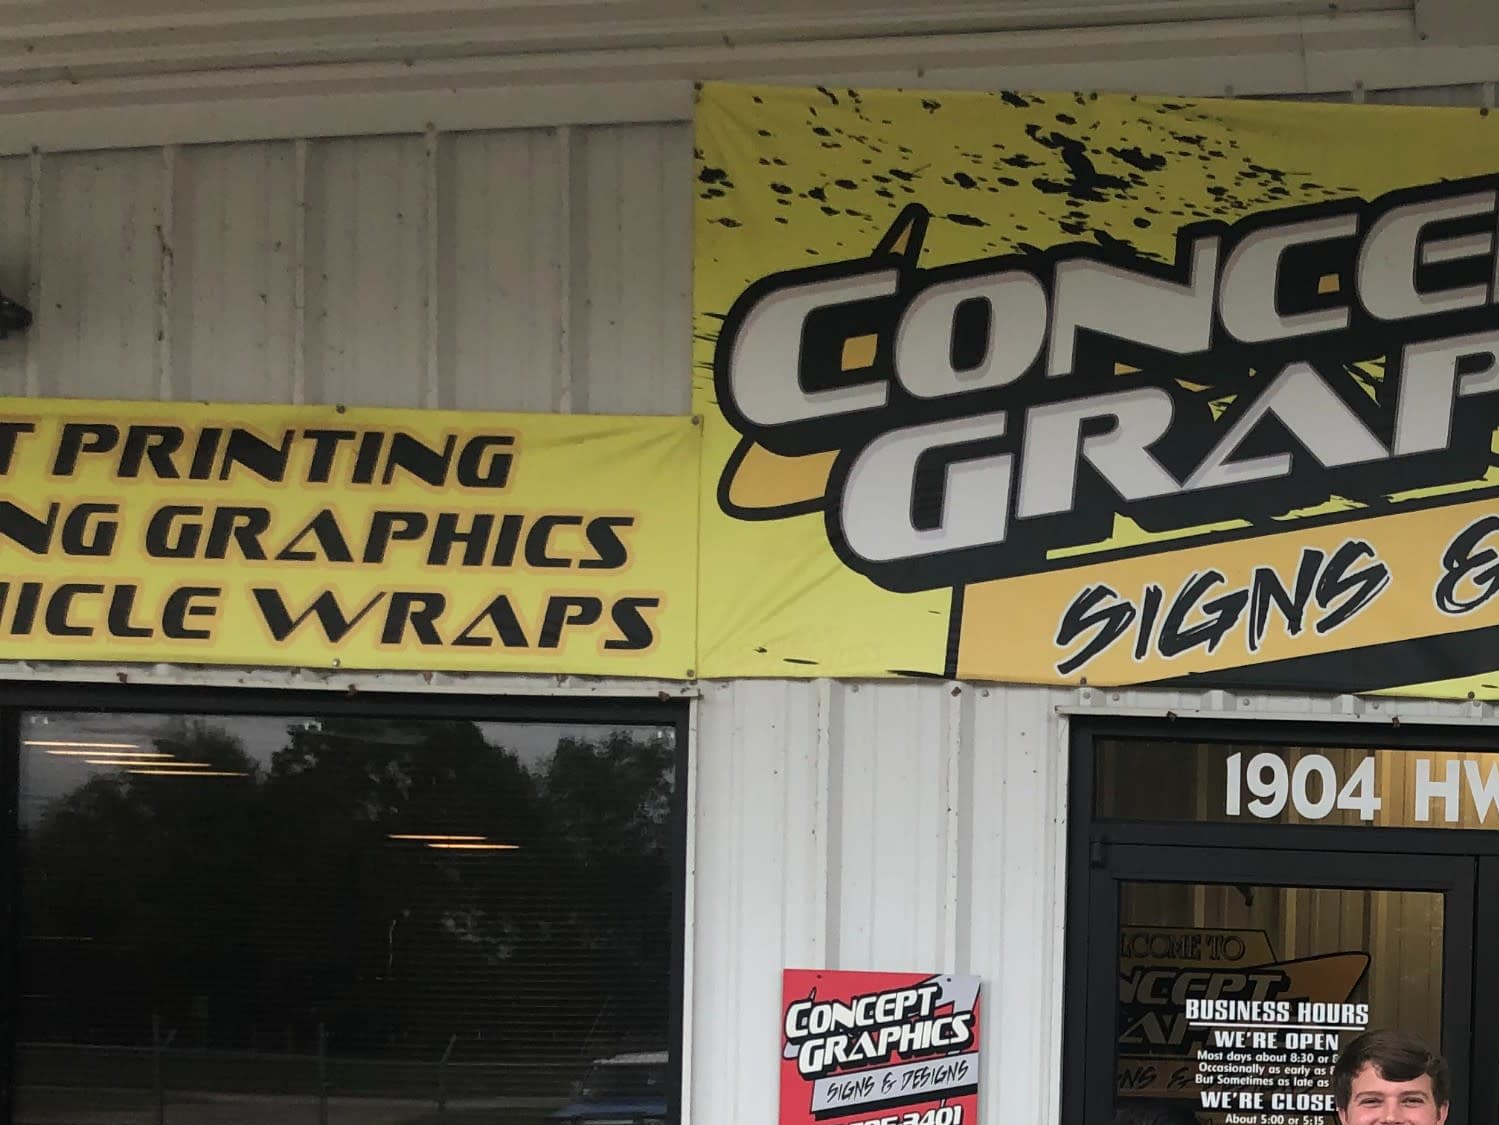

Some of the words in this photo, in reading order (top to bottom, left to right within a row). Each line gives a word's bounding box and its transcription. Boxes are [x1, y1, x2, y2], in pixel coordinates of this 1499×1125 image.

[52, 423, 515, 489] PRINTING
[146, 504, 634, 569] GRAPHICS
[0, 581, 221, 640] ICLE
[251, 588, 660, 651] WRAPS
[1055, 541, 1389, 674] SIGNS
[1225, 751, 1382, 821] 1904
[1206, 934, 1246, 962] TO
[786, 986, 938, 1038] CONCEPT
[1185, 999, 1290, 1022] BUSINESS
[1297, 1002, 1369, 1025] HOURS
[799, 1013, 971, 1074] GRAPHICS
[1197, 1050, 1223, 1061] Most
[1226, 1051, 1252, 1063] days
[1255, 1052, 1287, 1063] about
[1290, 1052, 1314, 1063] 8:30
[1317, 1055, 1329, 1063] or
[1213, 1030, 1278, 1049] WE'RE
[1285, 1033, 1339, 1050] OPEN
[827, 1074, 875, 1103] SIGNS
[881, 1071, 897, 1094] &
[900, 1060, 969, 1091] DESIGNS
[1195, 1074, 1214, 1084] But
[1217, 1075, 1274, 1086] Sometimes
[1277, 1077, 1290, 1086] as
[1293, 1076, 1314, 1087] late
[1316, 1079, 1330, 1087] as
[1198, 1063, 1265, 1077] Occasionally
[1268, 1067, 1281, 1075] as
[1284, 1065, 1310, 1077] early
[1314, 1067, 1327, 1076] as
[1200, 1091, 1264, 1109] WE'RE
[1271, 1093, 1339, 1112] CLOSE
[1225, 1113, 1257, 1124] About
[1260, 1114, 1285, 1125] 5:00
[1288, 1117, 1300, 1125] or
[1303, 1115, 1324, 1125] 5:15
